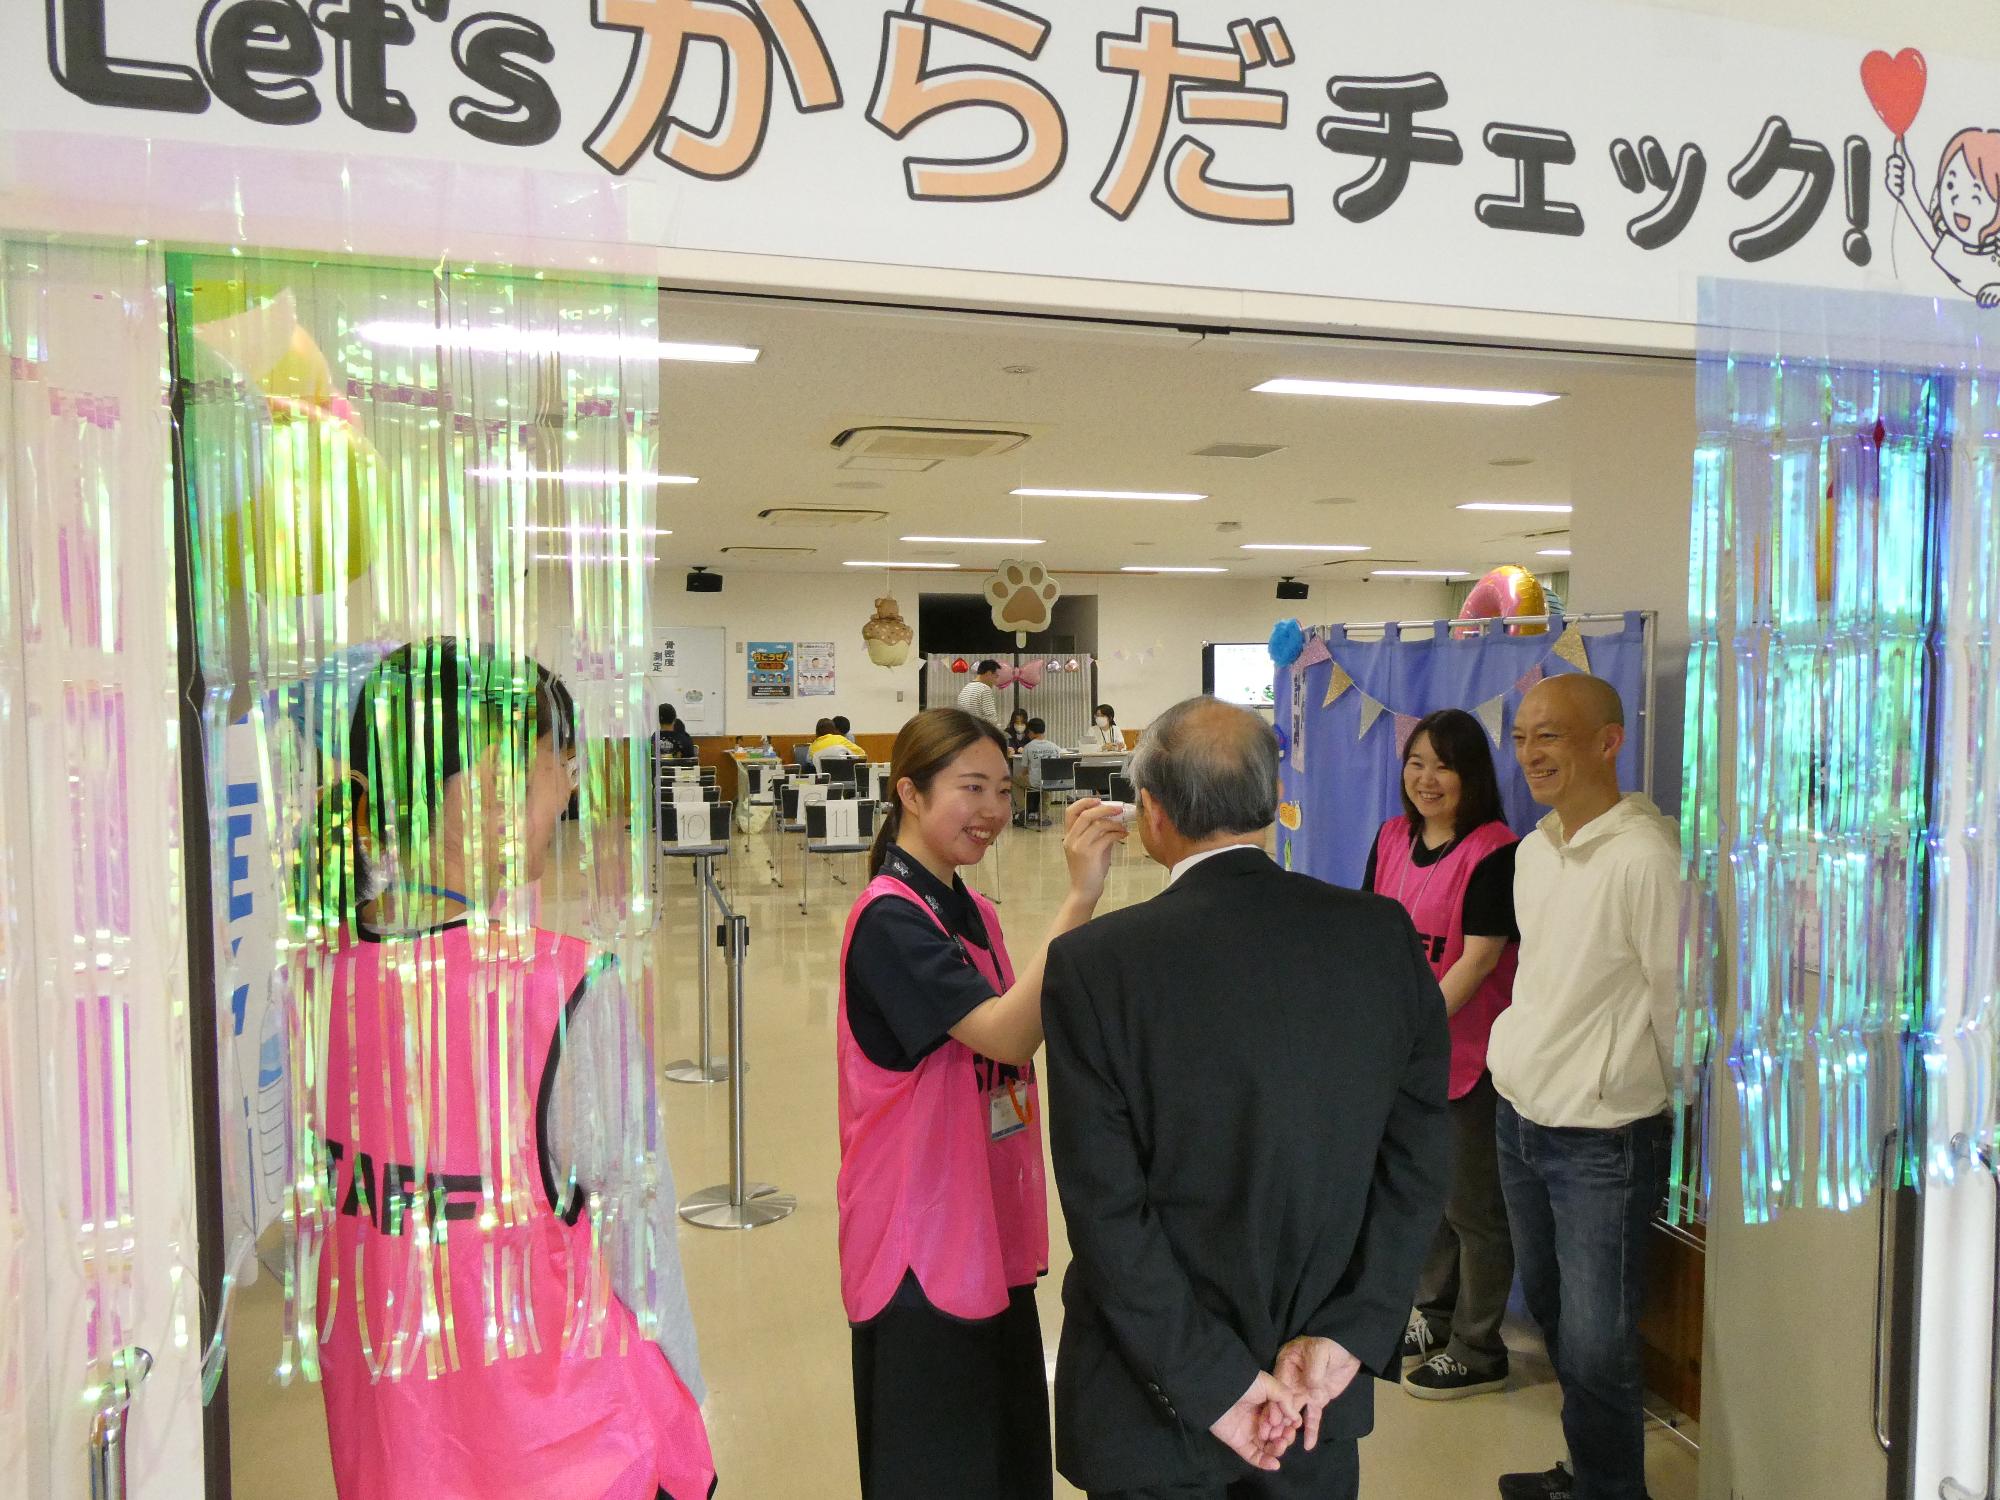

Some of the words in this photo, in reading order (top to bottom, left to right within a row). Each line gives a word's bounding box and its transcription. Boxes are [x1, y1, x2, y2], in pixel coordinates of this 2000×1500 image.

[46, 0, 562, 147] Let's
[652, 651, 663, 672] 測定
[664, 640, 676, 667] 骨密度
[680, 814, 706, 840] 10
[831, 808, 849, 837] 11
